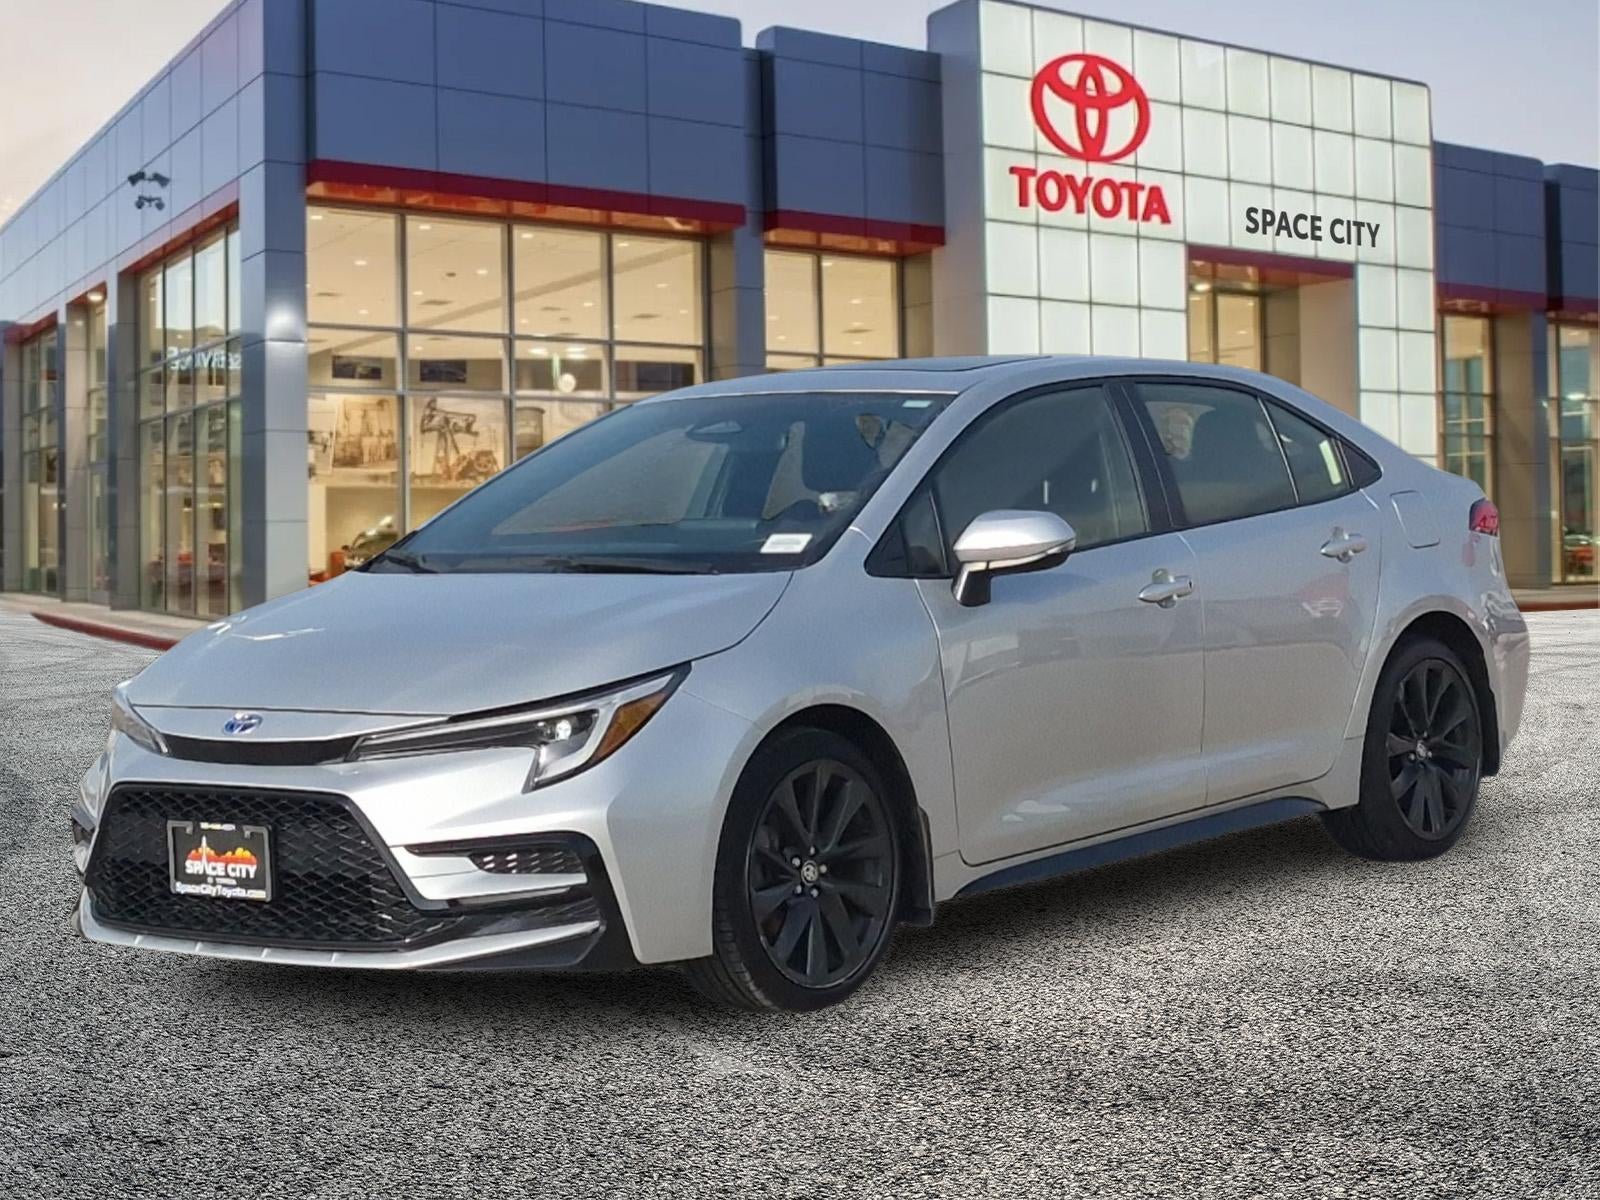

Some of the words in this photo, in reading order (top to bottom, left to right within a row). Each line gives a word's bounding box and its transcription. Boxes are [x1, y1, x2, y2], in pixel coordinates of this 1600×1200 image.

[1009, 166, 1171, 224] TOYOTA
[1245, 206, 1323, 241] SPACE
[1329, 218, 1381, 248] CITY
[185, 859, 226, 876] SPACE
[227, 862, 257, 879] CITY
